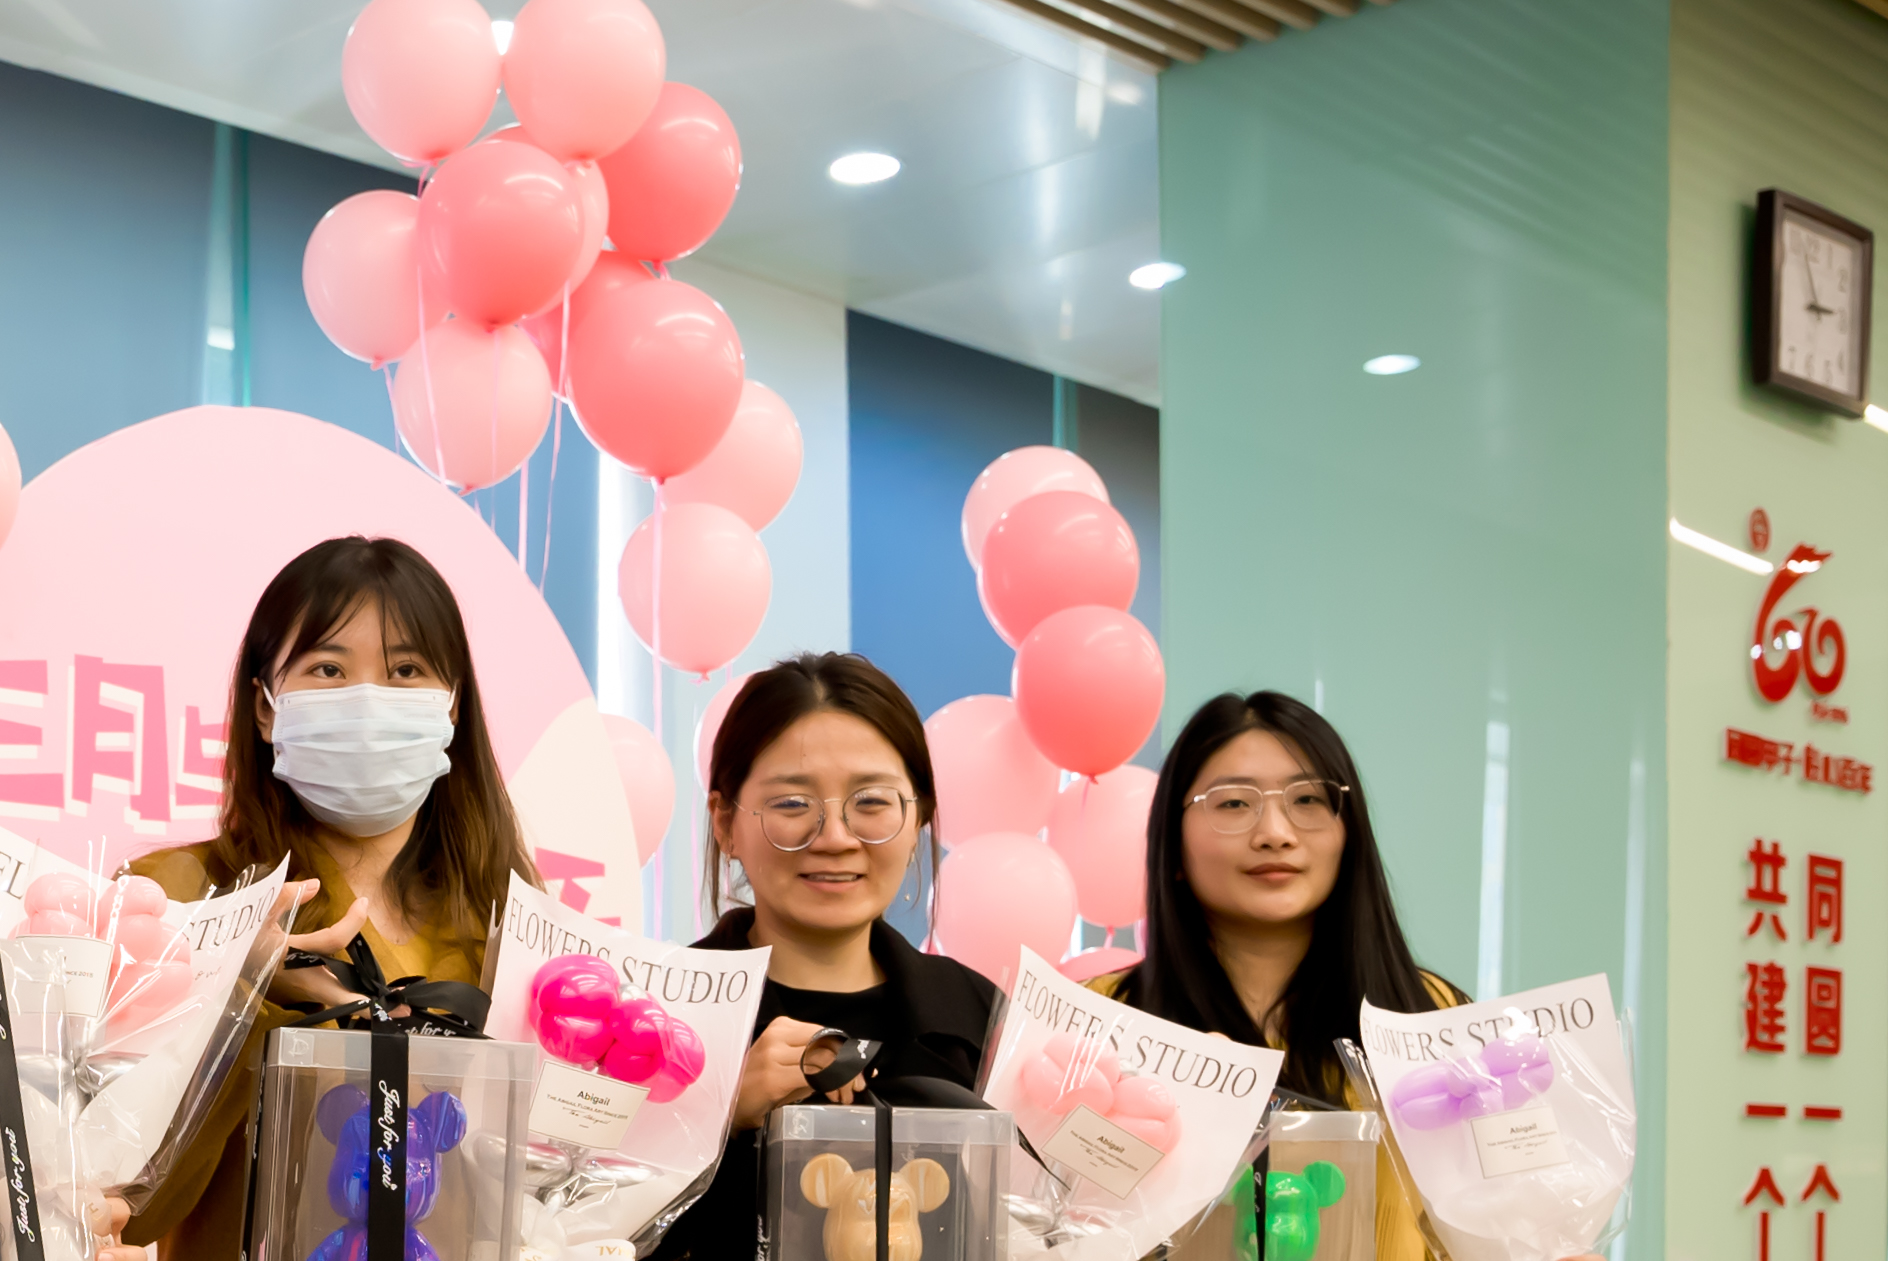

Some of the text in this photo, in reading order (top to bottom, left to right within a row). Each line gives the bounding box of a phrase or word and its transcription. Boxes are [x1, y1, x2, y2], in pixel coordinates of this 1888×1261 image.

[182, 885, 277, 954] TUDIO
[622, 955, 748, 1004] STUDIO
[1017, 969, 1258, 1099] FLOWERS STUDIO
[377, 1079, 401, 1190] Just for you
[577, 1090, 611, 1106] Abigail
[5, 1127, 36, 1243] Just for you
